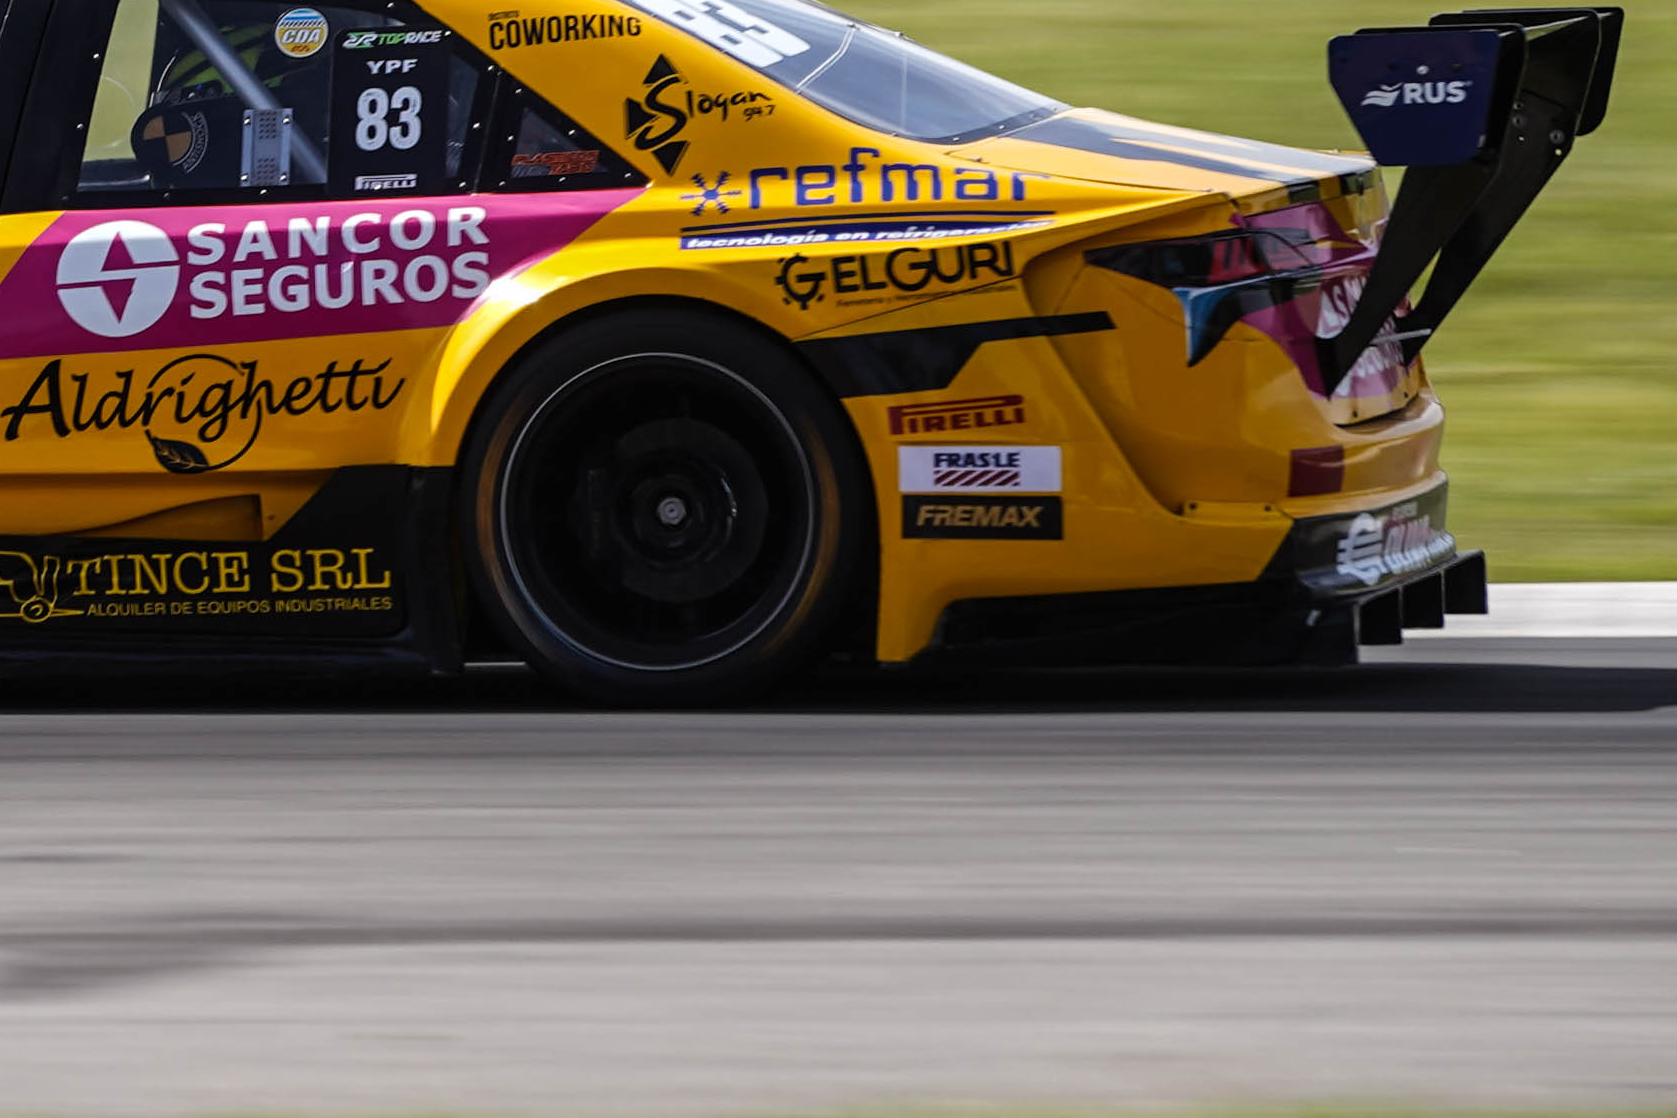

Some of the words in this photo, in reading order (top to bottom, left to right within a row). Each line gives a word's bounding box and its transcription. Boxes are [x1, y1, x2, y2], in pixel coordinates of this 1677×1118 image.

[489, 14, 642, 50] COWORKING
[367, 59, 418, 74] YPF
[1403, 81, 1466, 104] RUS
[355, 86, 422, 151] 83
[355, 174, 417, 191] PIRELLI
[749, 147, 1051, 209] refmar
[186, 206, 491, 266] SANCOR
[835, 230, 869, 242] en
[190, 251, 491, 319] SEGUROS
[0, 356, 406, 443] Aldrighetti
[887, 394, 1025, 435] PIRELLI
[916, 505, 1044, 527] FREMAX
[66, 550, 251, 596] TINCE
[270, 548, 392, 594] SRL
[87, 600, 168, 617] ALQUILER
[171, 601, 193, 614] DE
[197, 599, 272, 615] EQUIPOS
[275, 596, 393, 612] INDUSTRIALES
